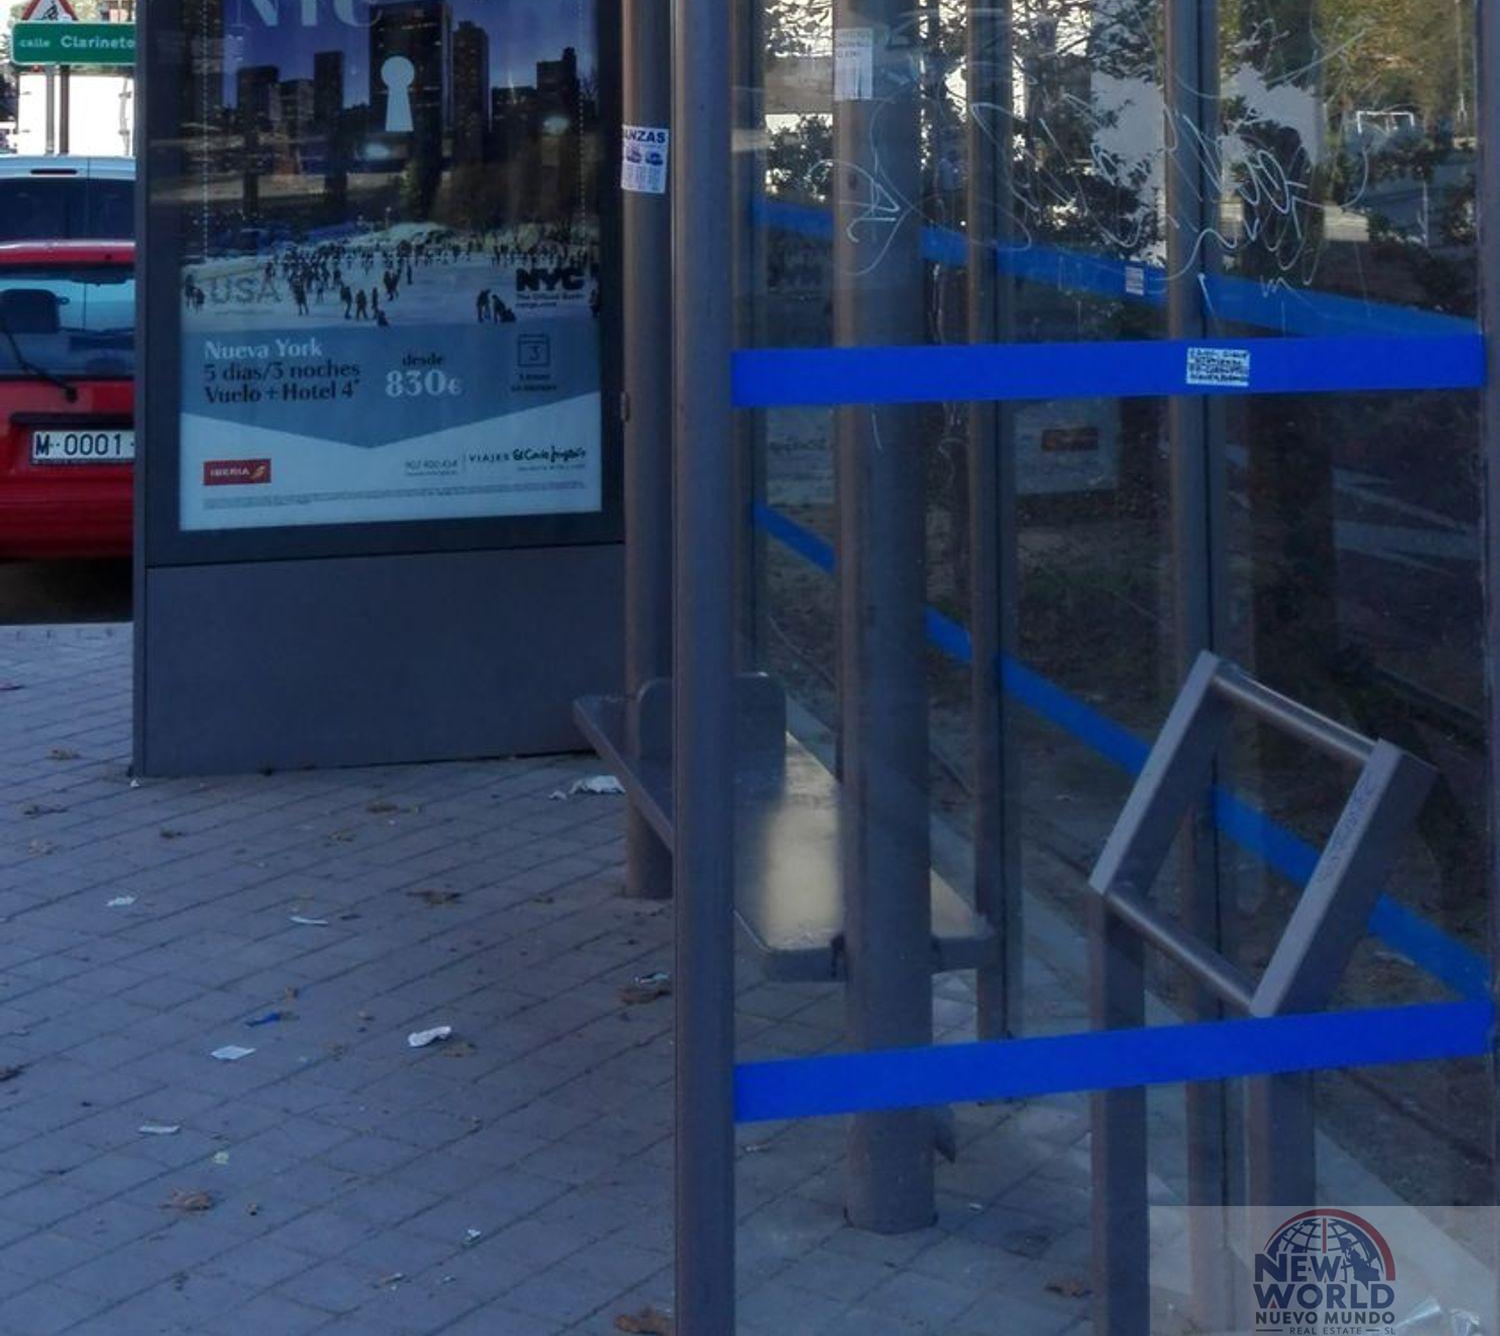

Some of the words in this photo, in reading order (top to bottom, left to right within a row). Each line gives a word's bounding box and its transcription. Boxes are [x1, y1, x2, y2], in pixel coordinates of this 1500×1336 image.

[20, 38, 50, 48] calle
[60, 35, 136, 49] Clarineto
[516, 267, 585, 291] NYC
[204, 340, 269, 360] Nueva
[275, 336, 322, 357] York
[402, 351, 445, 367] desde
[289, 358, 360, 379] noches
[204, 383, 262, 404] Vuelo
[282, 380, 336, 401] Hotel
[384, 369, 462, 397] 830€
